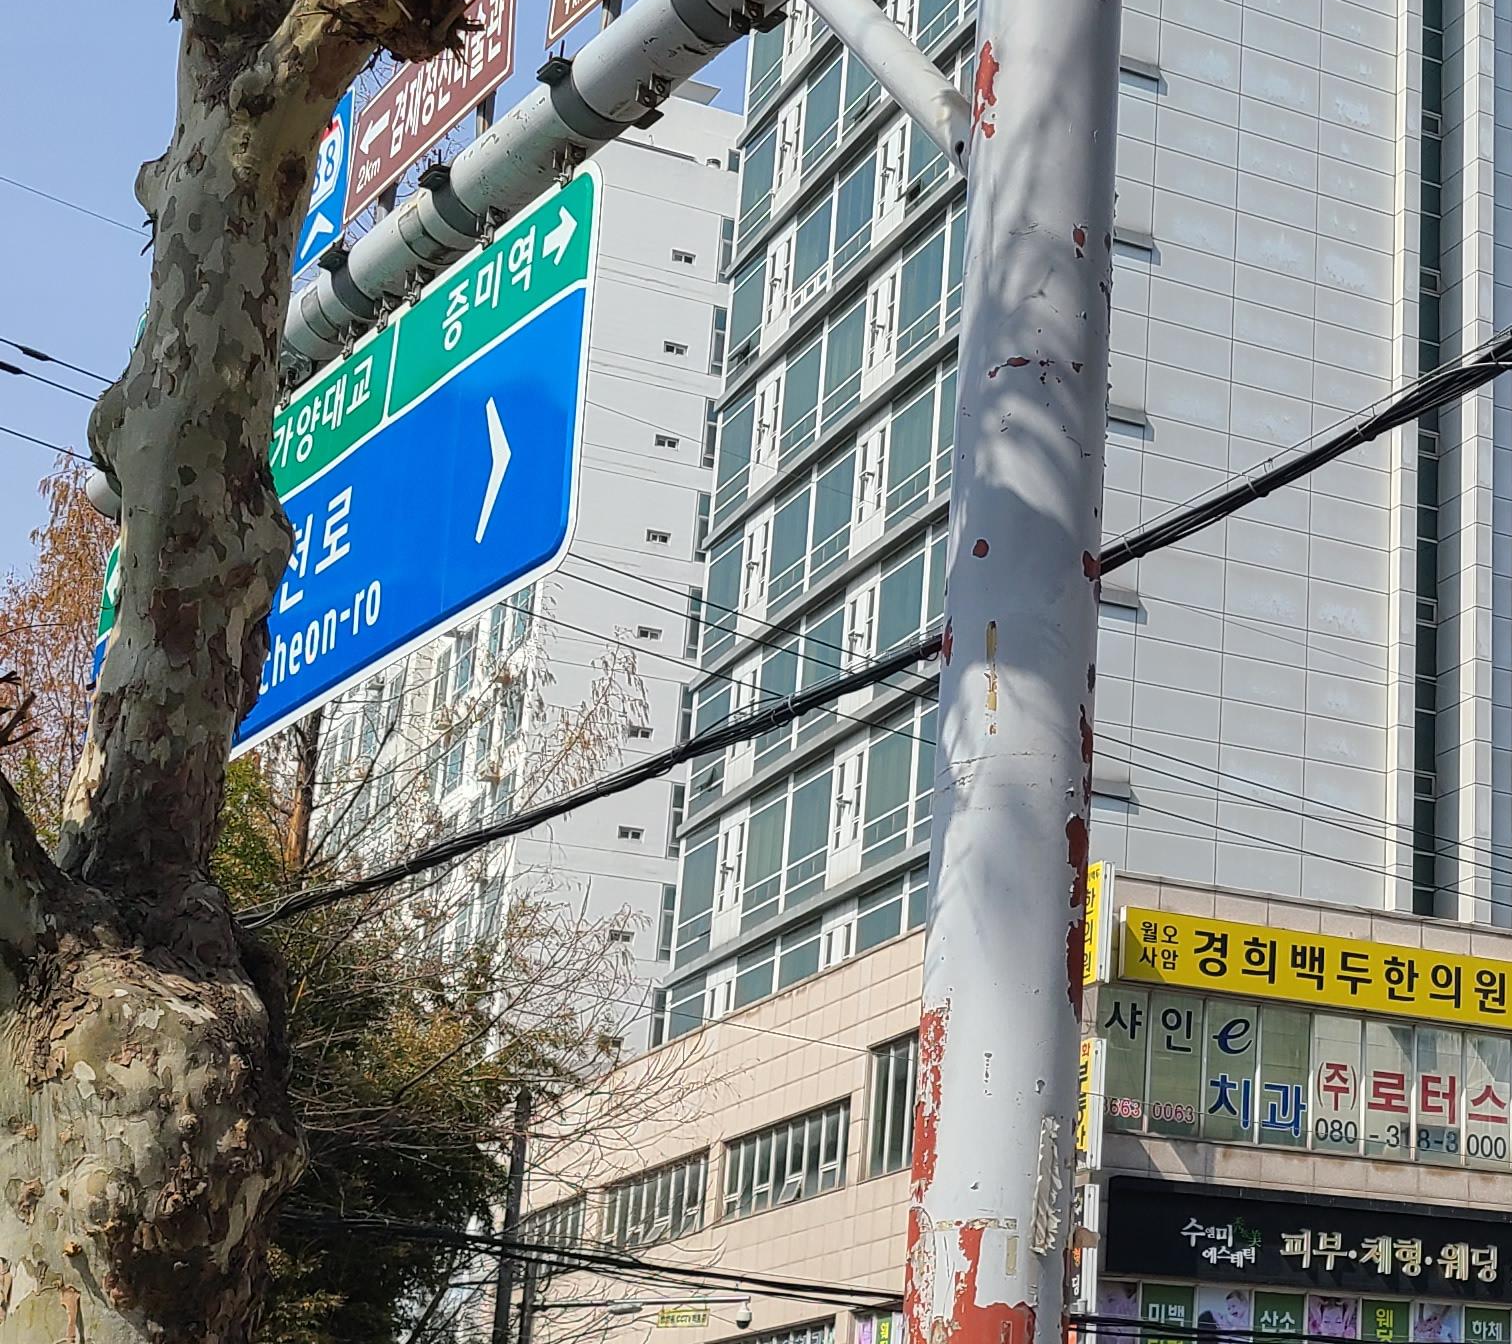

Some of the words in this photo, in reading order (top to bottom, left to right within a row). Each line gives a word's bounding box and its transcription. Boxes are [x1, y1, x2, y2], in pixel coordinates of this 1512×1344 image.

[356, 158, 381, 194] 2km
[441, 224, 536, 351] 증미역
[270, 355, 374, 469] 가양대교
[1193, 930, 1507, 1014] 경희백두한의원
[1208, 1073, 1306, 1137] 치과
[1316, 1061, 1508, 1125] (주)로터스
[1202, 1246, 1256, 1269] 에스테틱
[1148, 1303, 1185, 1327] 미백
[1260, 1310, 1296, 1333] 산소
[1471, 1319, 1502, 1341] 하체
